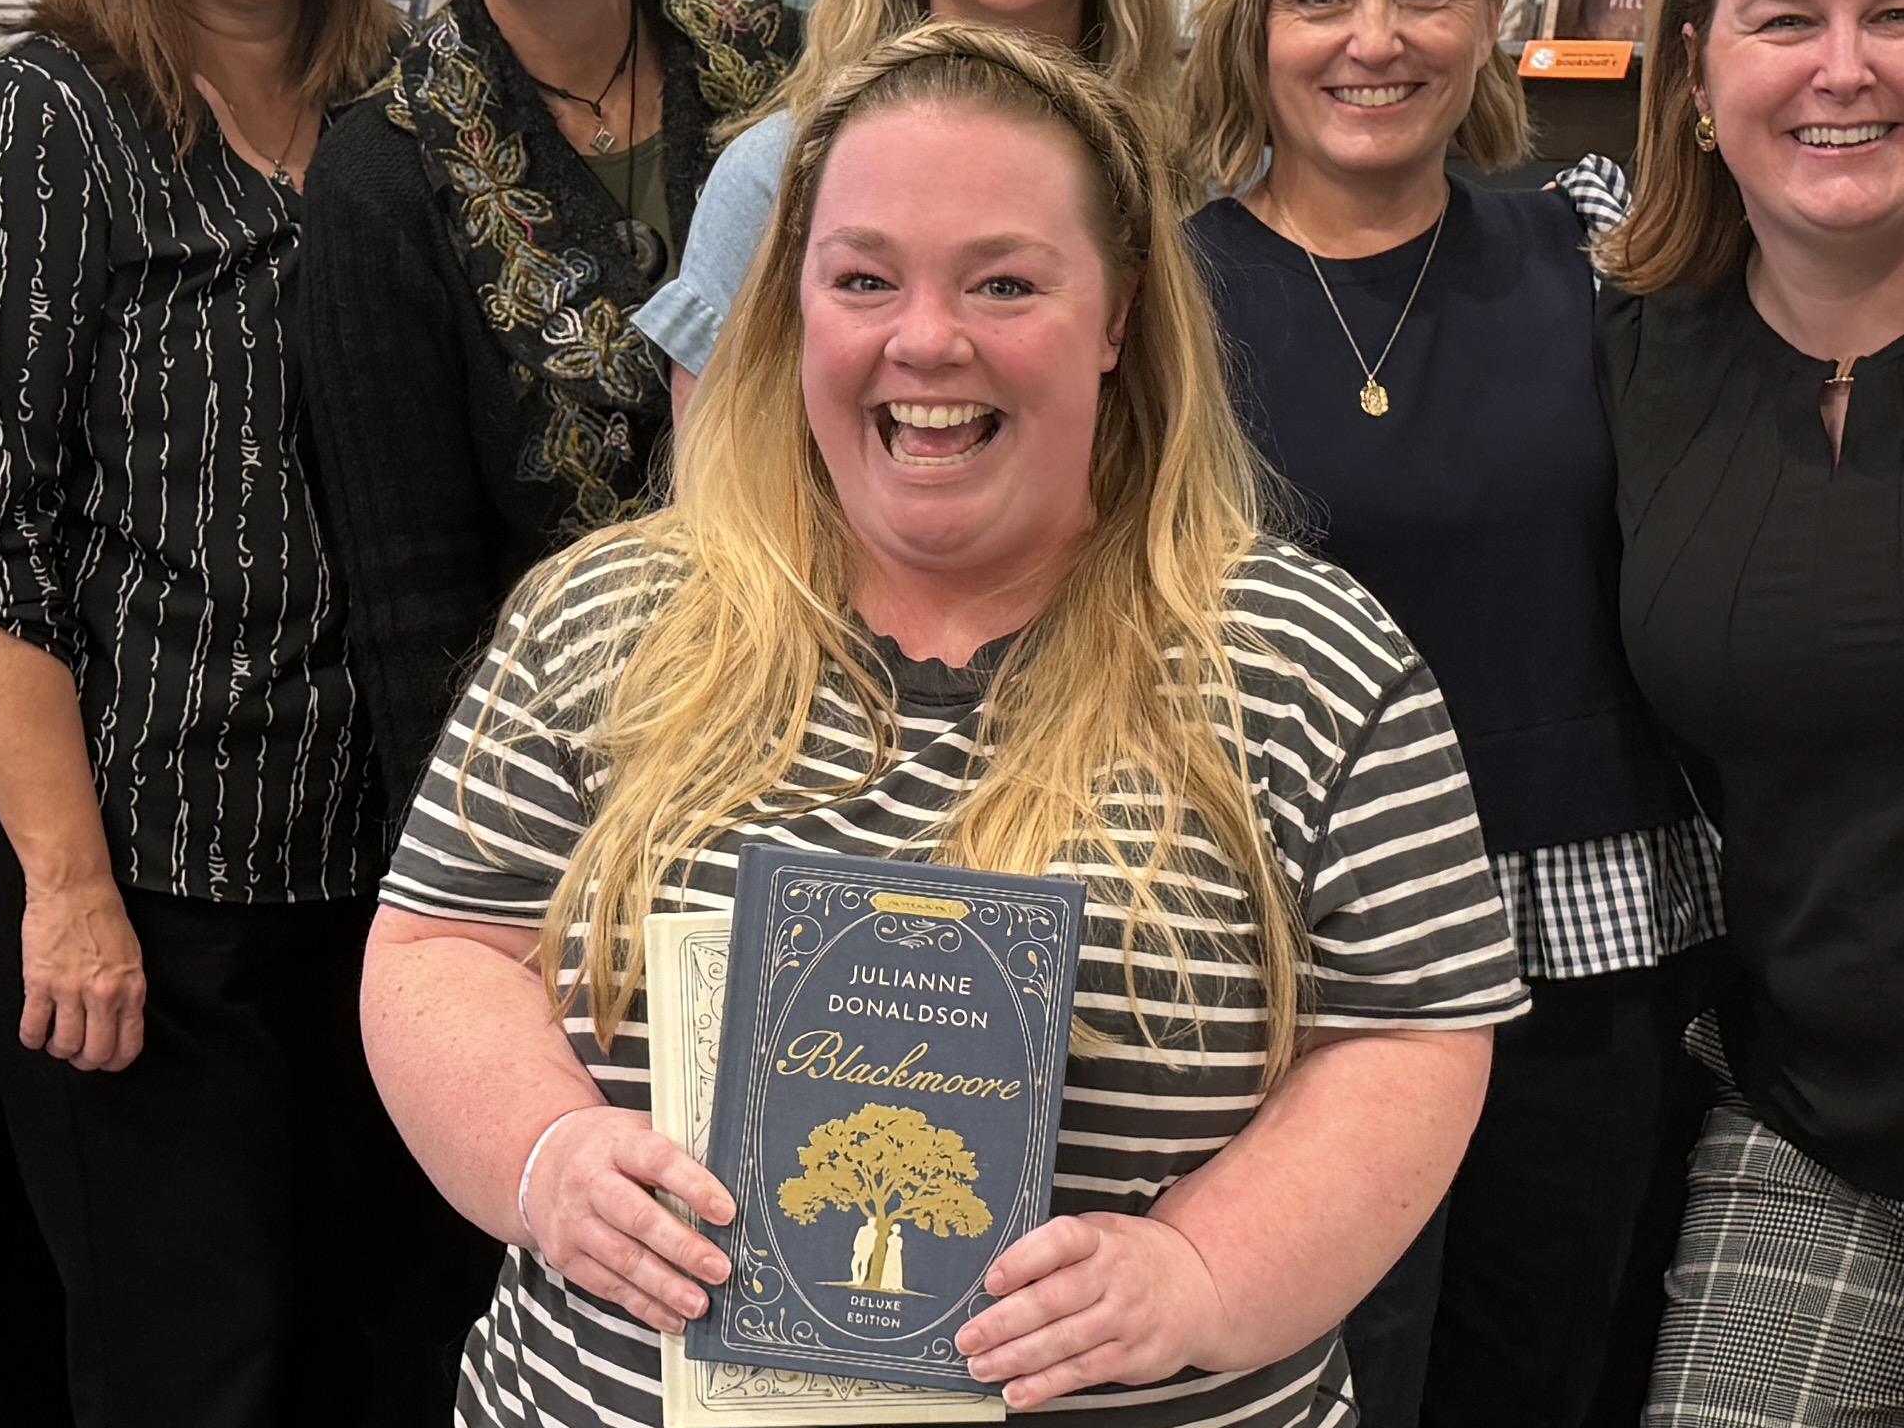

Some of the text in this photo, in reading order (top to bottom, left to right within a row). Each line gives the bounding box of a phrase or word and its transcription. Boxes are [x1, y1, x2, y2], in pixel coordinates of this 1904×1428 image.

[848, 964, 974, 997] JULIANNE
[828, 993, 990, 1030] DONALDSON
[775, 1029, 1025, 1102] Blackmoore
[849, 1294, 903, 1312] DELUXE
[846, 1313, 902, 1330] EDITION
